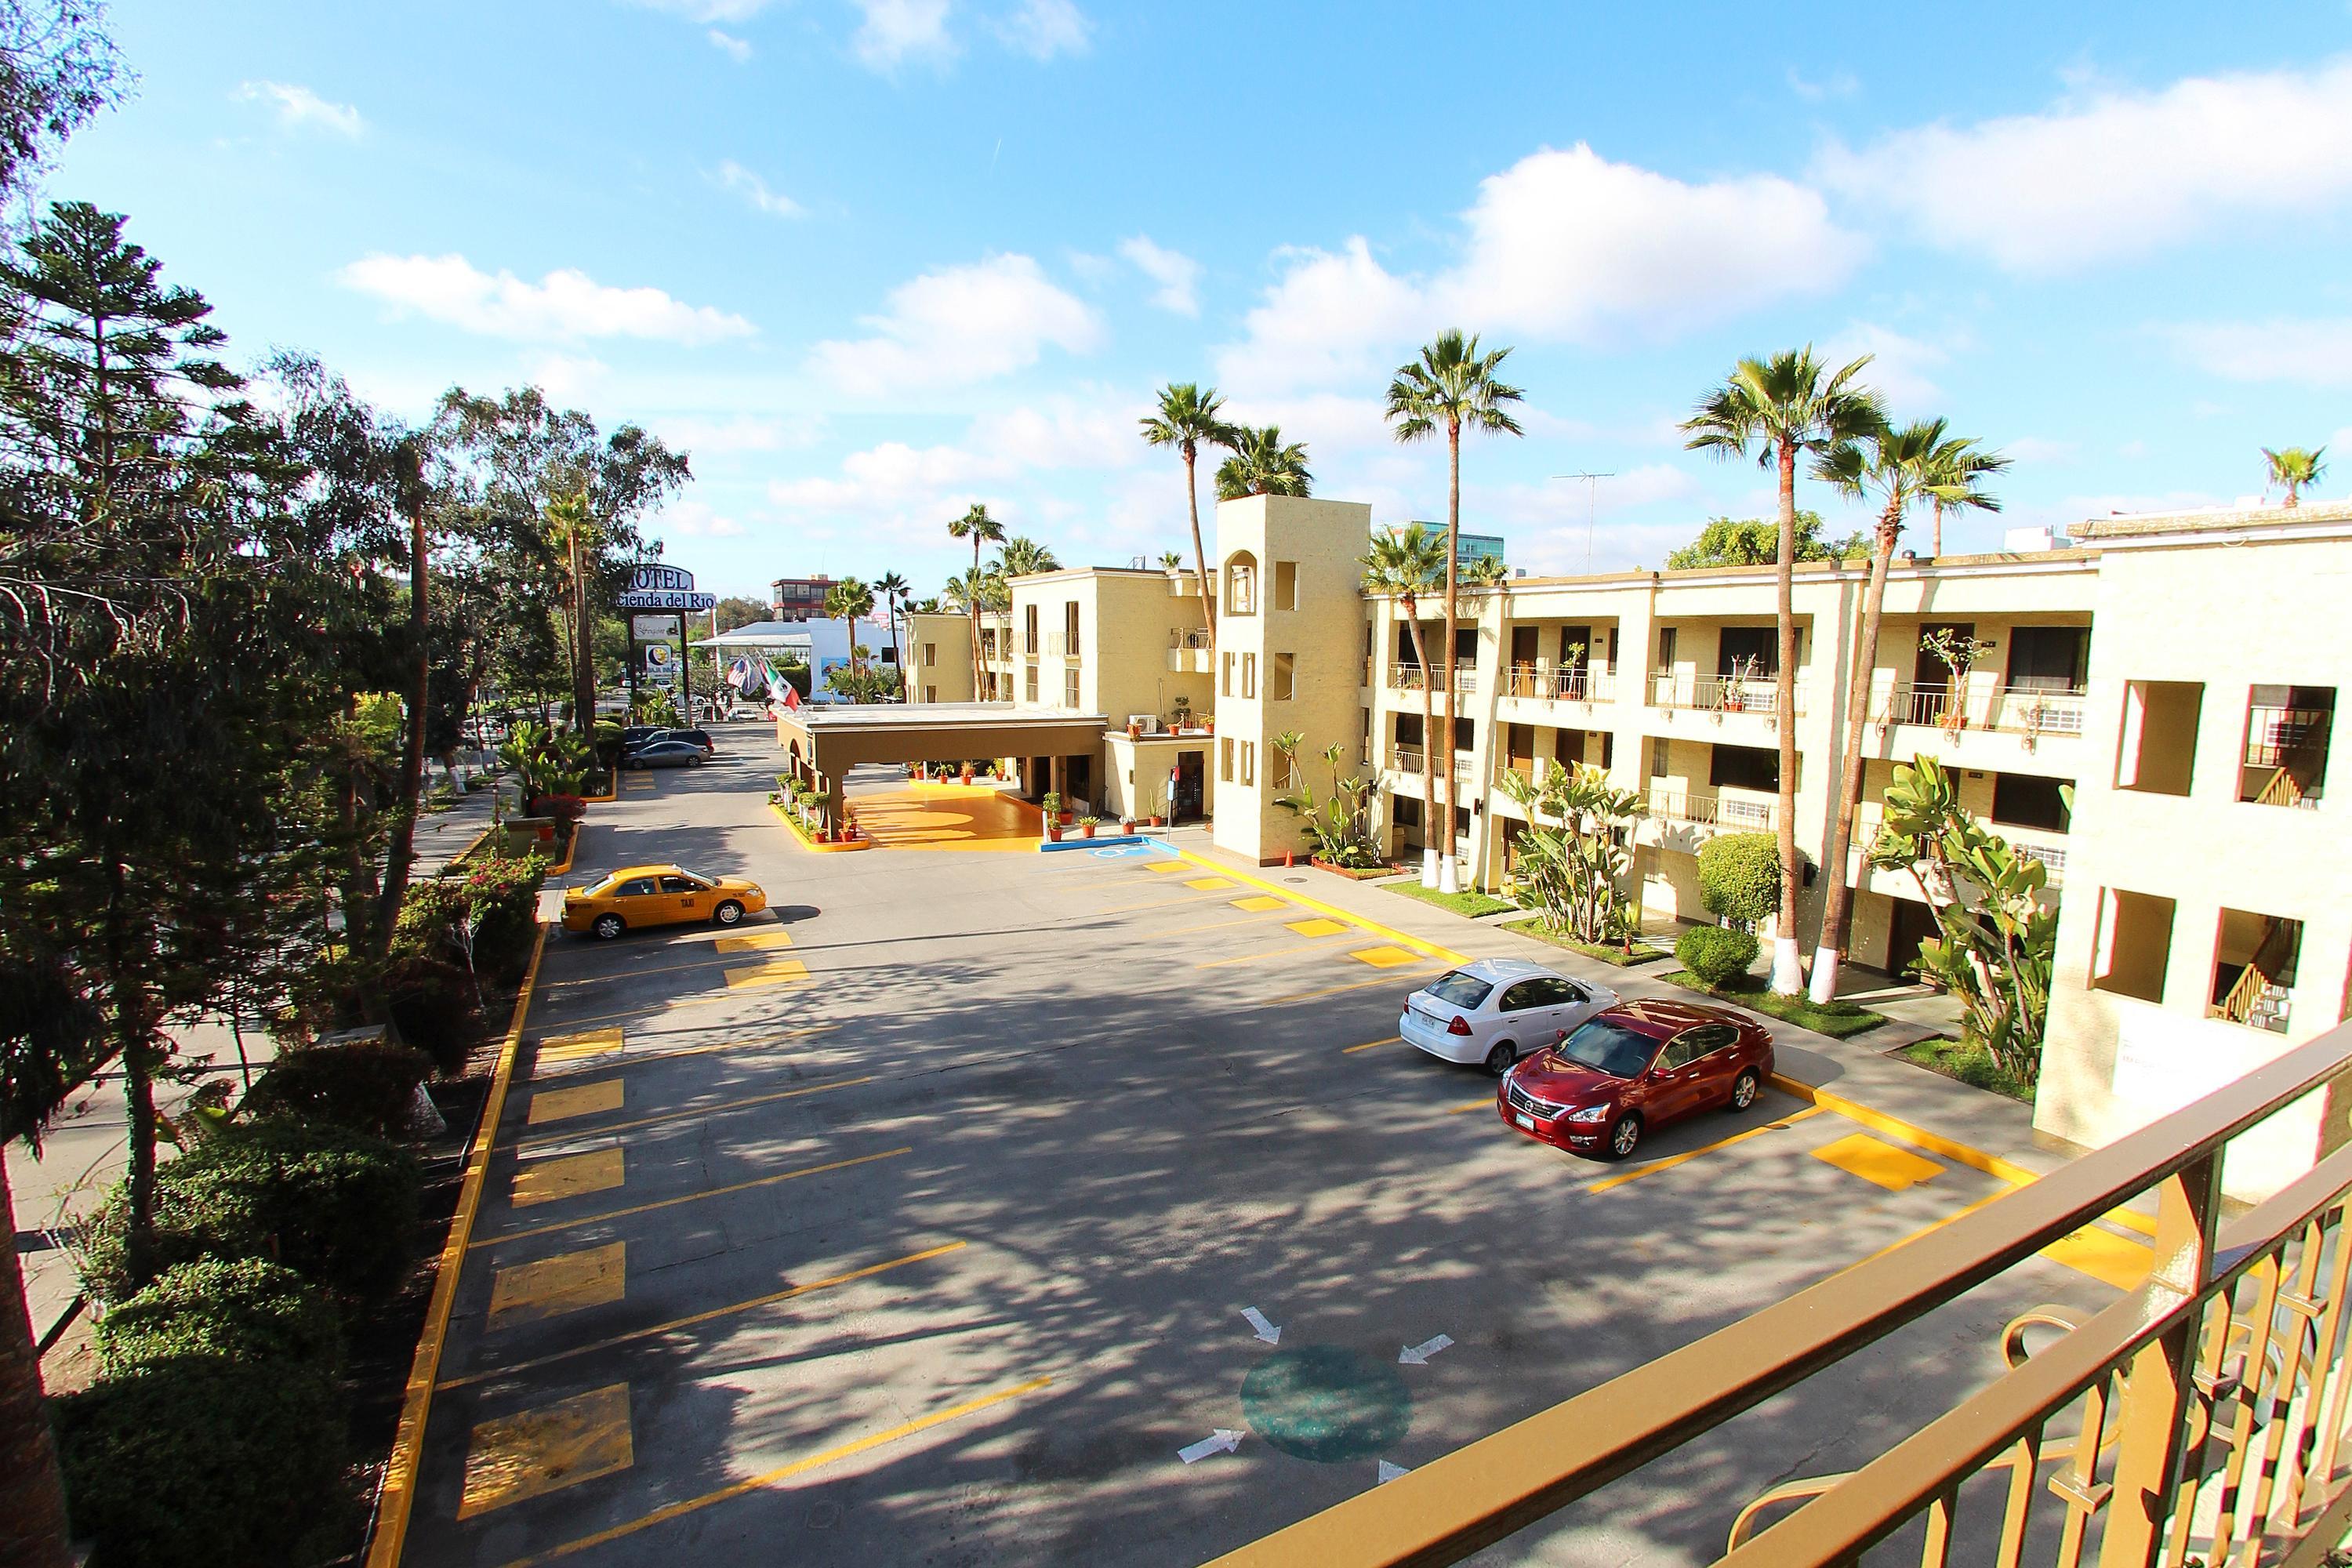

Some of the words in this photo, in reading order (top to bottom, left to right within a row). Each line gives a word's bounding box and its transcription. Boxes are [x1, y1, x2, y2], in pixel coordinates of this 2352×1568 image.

[617, 593, 662, 607] cienda
[666, 594, 686, 607] del
[681, 898, 695, 908] TAXI
